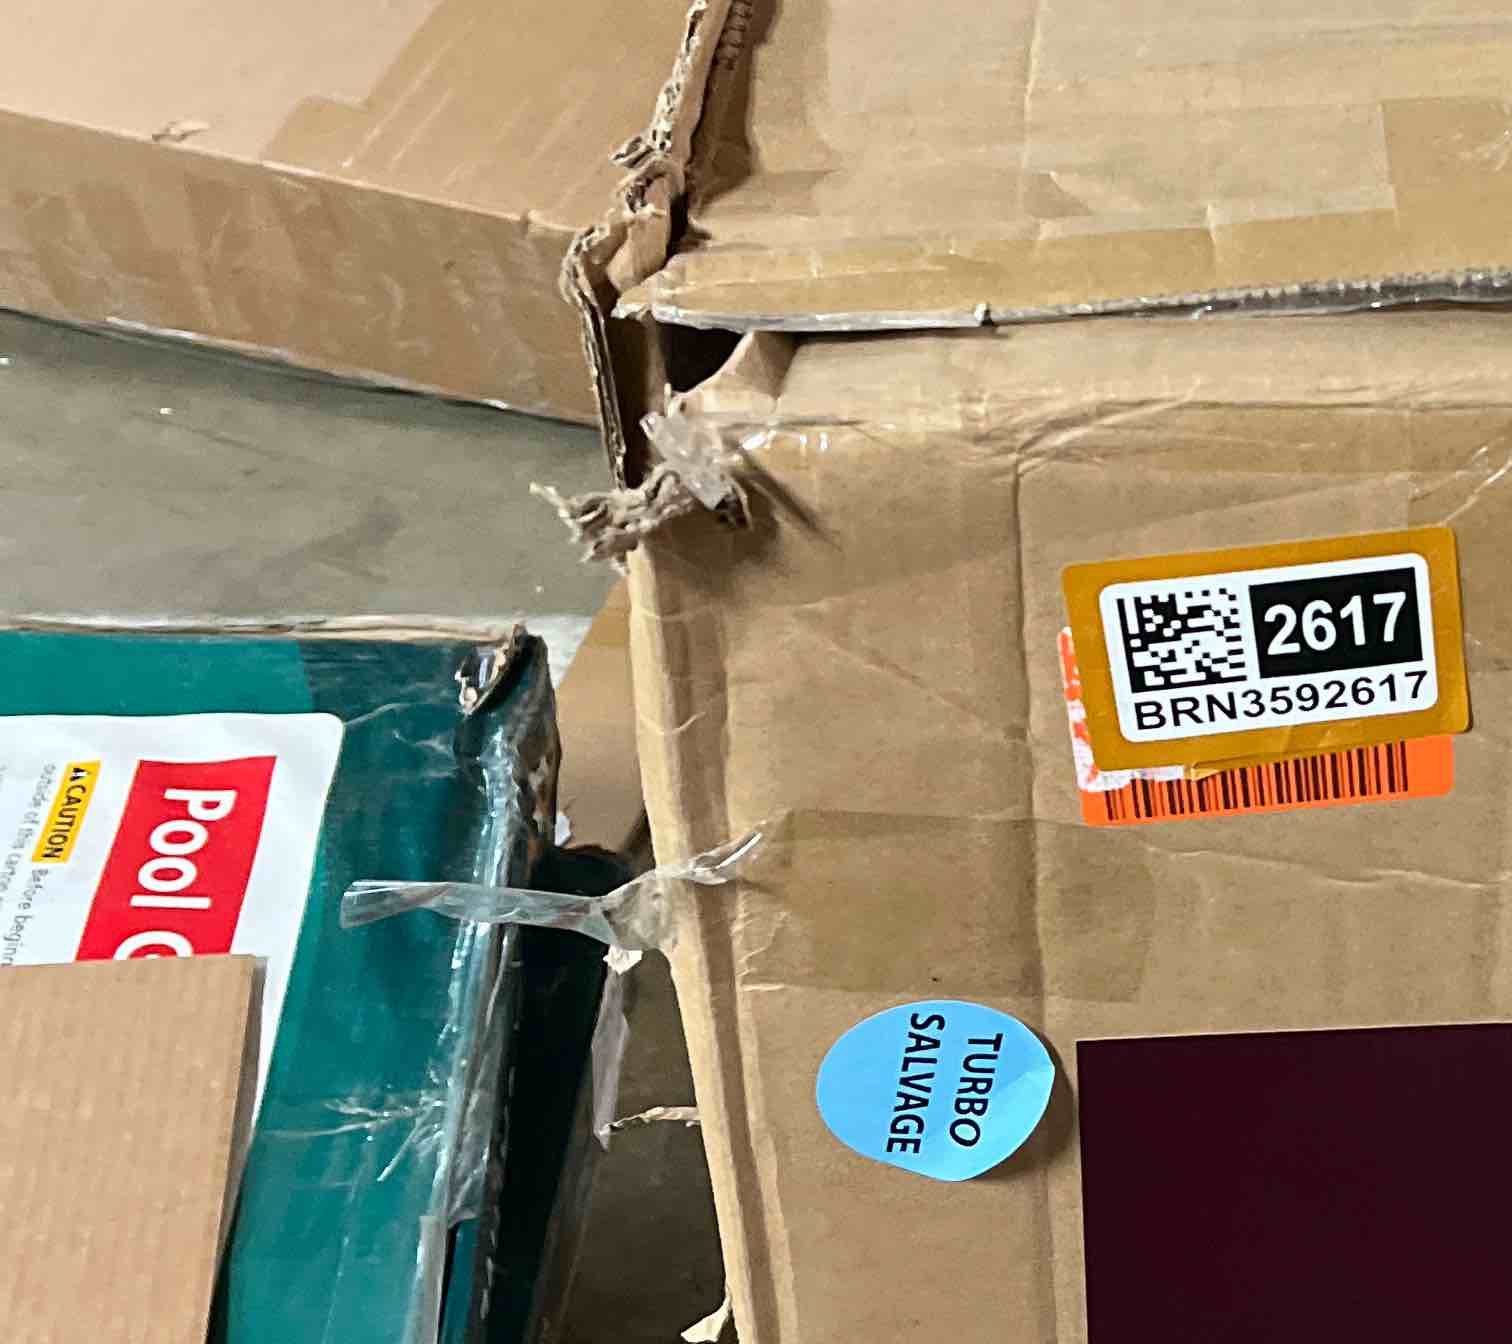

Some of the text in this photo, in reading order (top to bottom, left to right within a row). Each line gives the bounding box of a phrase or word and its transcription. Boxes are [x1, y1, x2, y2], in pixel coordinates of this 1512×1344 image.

[1263, 591, 1407, 656] 2617
[1133, 670, 1428, 731] BRN3592617
[42, 784, 87, 859] CAUTION
[130, 788, 238, 909] Pool
[886, 1012, 945, 1153] SALVAGE
[949, 1032, 1003, 1147] TURBO
